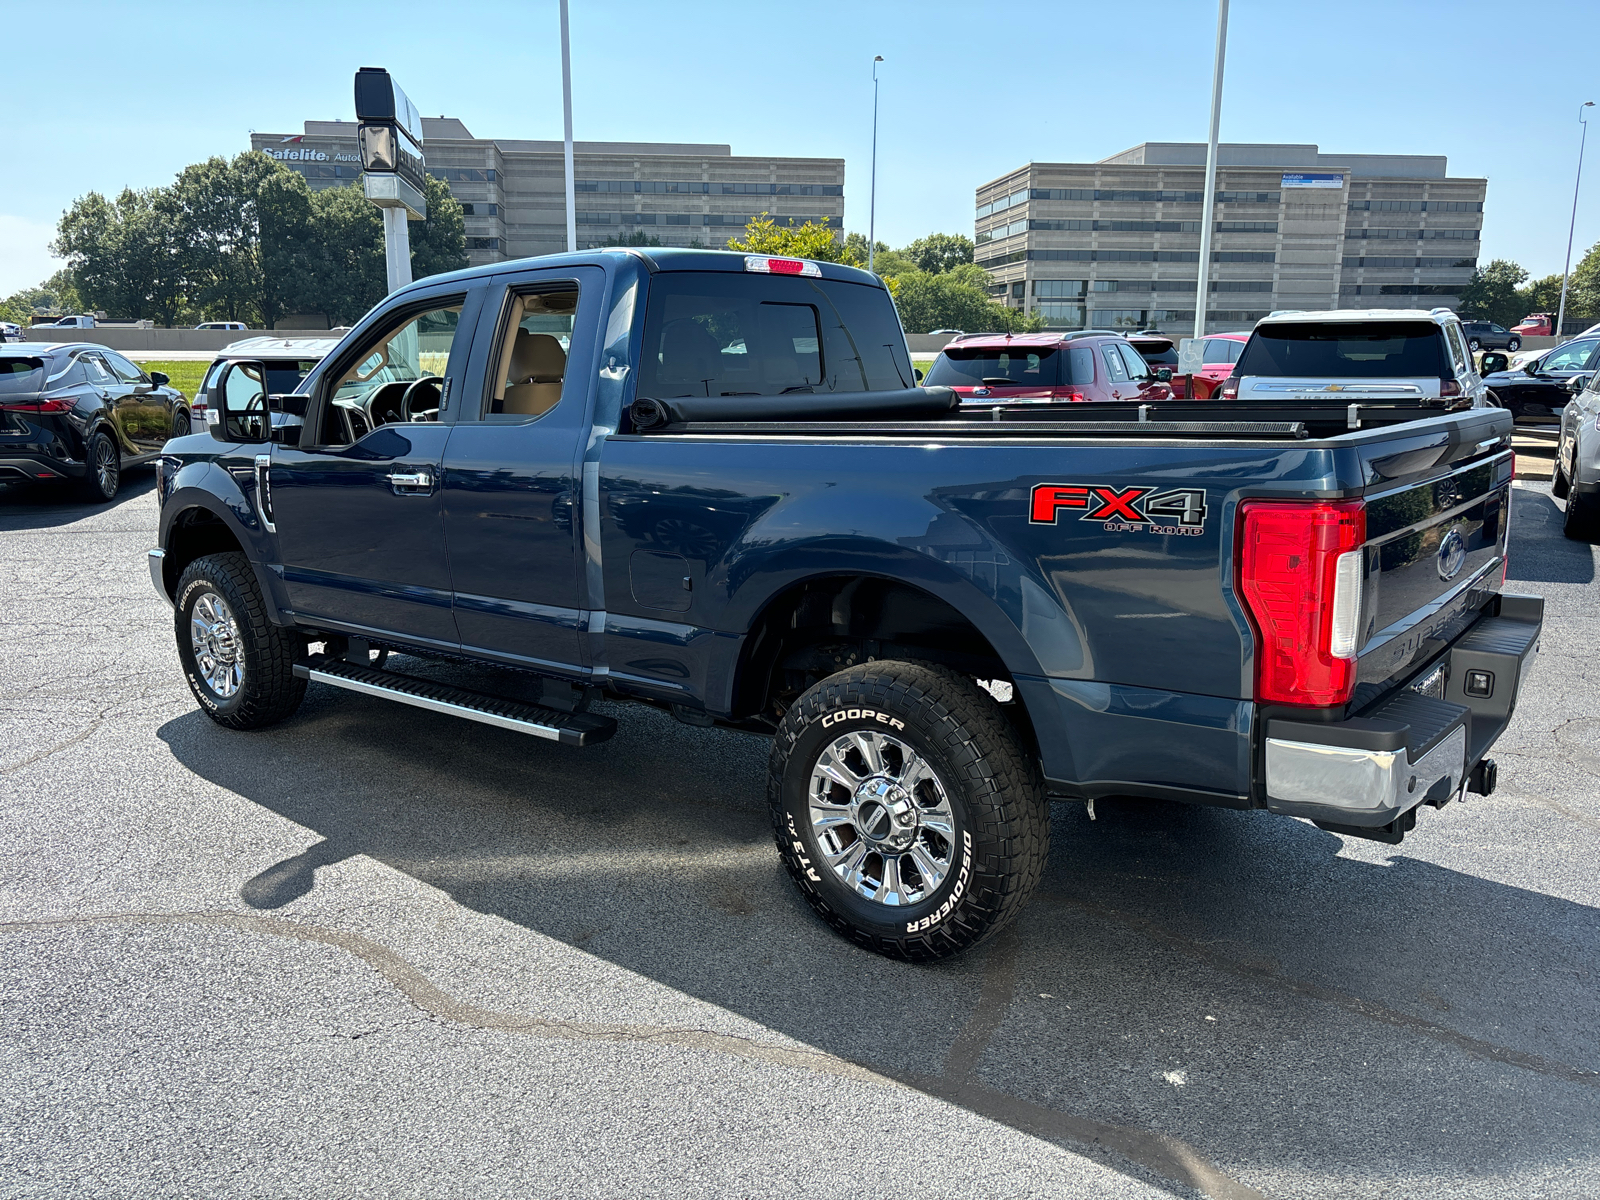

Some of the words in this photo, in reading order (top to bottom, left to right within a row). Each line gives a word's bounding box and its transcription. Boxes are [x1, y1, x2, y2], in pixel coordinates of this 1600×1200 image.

[1029, 483, 1207, 526] FX4
[1104, 523, 1143, 533] OFF
[1150, 526, 1204, 536] ROAD
[180, 580, 212, 611] DISCOVERER
[189, 673, 218, 710] COOPER
[822, 709, 905, 731] COOPER
[786, 811, 798, 837] XLT
[866, 810, 882, 831] FORD
[906, 830, 972, 933] DISCOVERER
